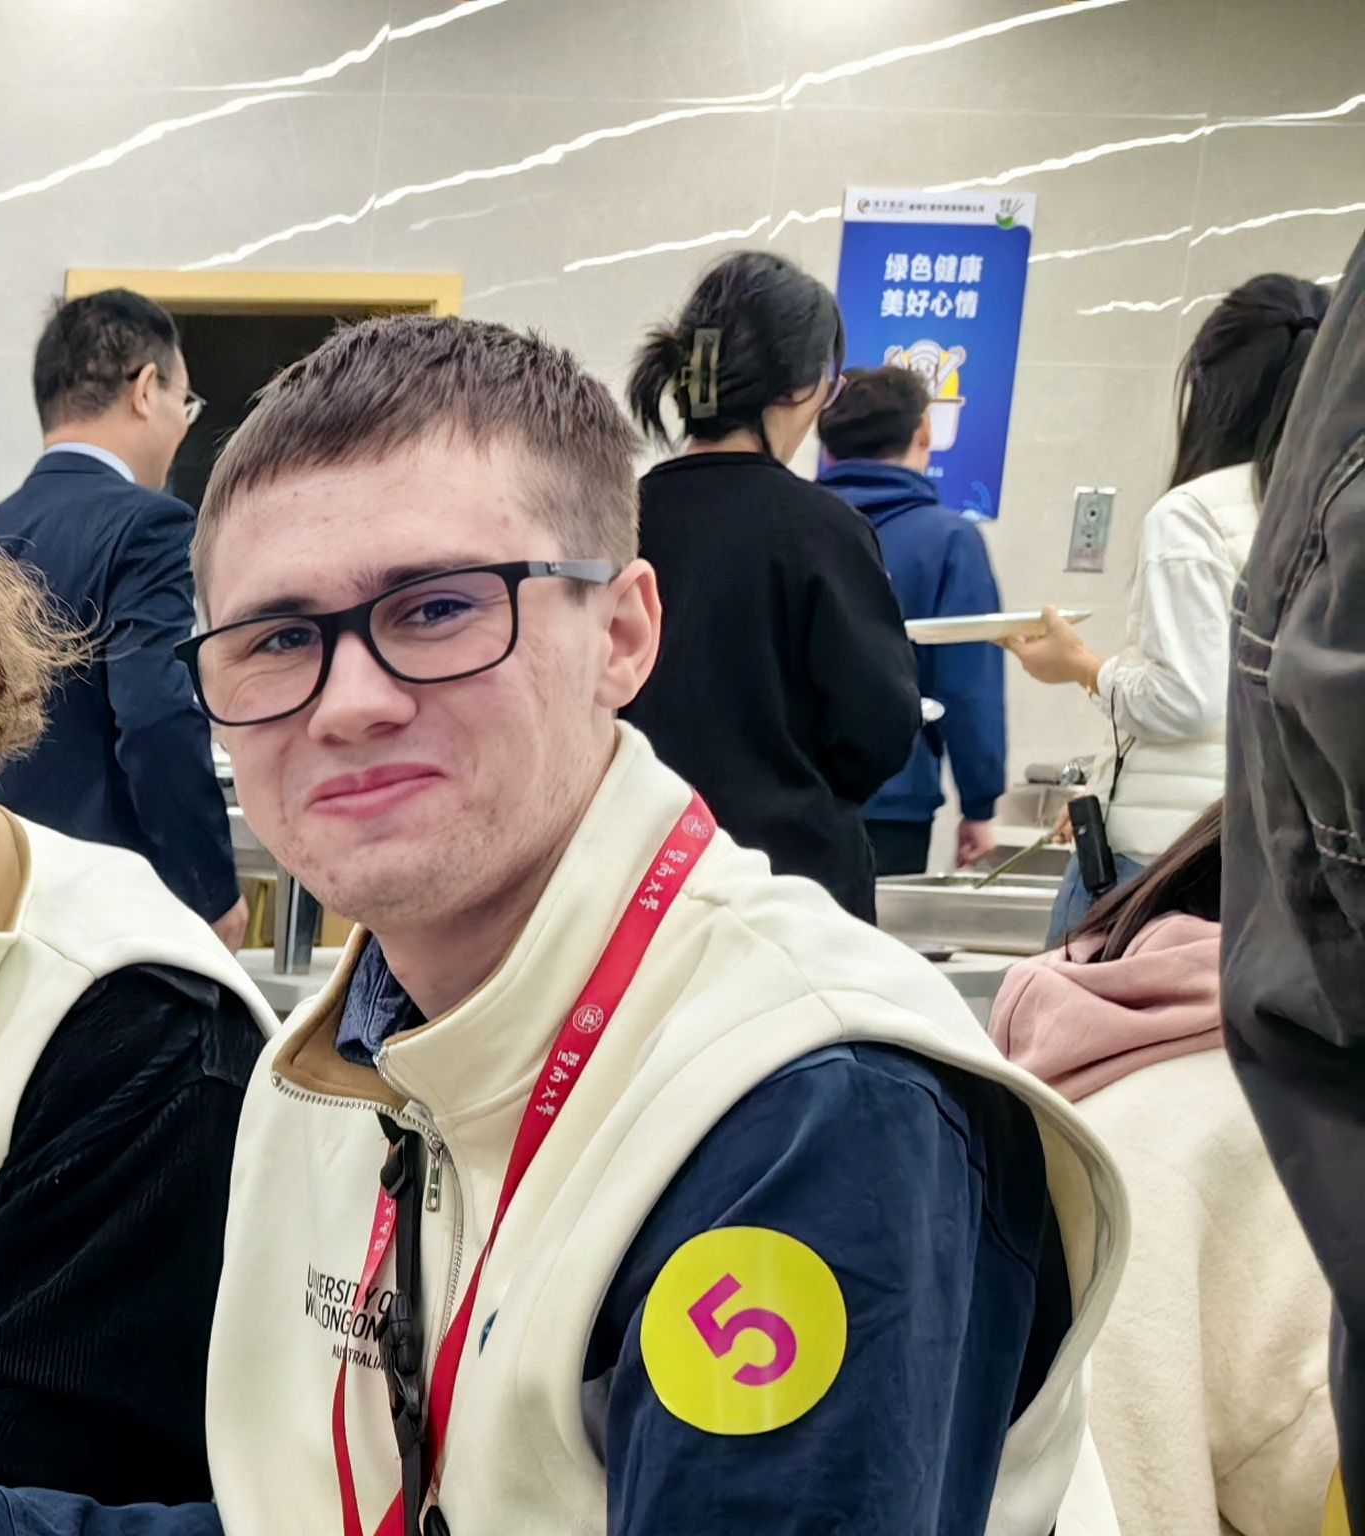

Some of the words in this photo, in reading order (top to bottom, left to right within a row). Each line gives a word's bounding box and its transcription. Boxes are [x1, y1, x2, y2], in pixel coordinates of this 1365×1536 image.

[884, 252, 983, 283] 绿色健康
[880, 288, 979, 319] 美好心情
[305, 1290, 381, 1342] WONGON
[687, 1272, 797, 1387] 5
